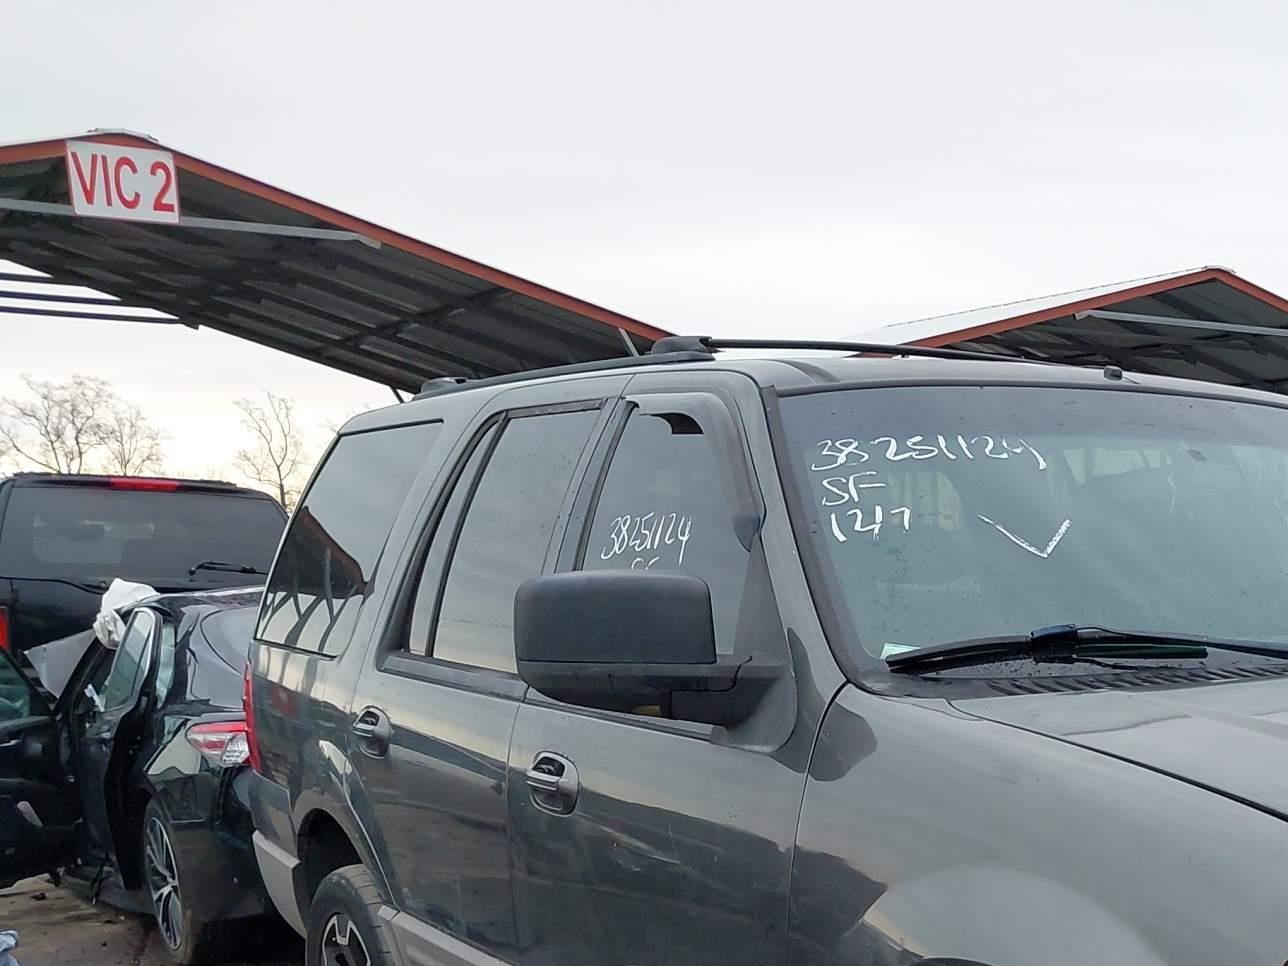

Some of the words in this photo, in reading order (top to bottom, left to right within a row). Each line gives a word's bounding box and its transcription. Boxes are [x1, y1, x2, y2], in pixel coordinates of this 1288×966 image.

[71, 151, 141, 209] VIC
[150, 161, 175, 212] 2
[822, 471, 887, 506] SF
[600, 511, 692, 566] 38251124
